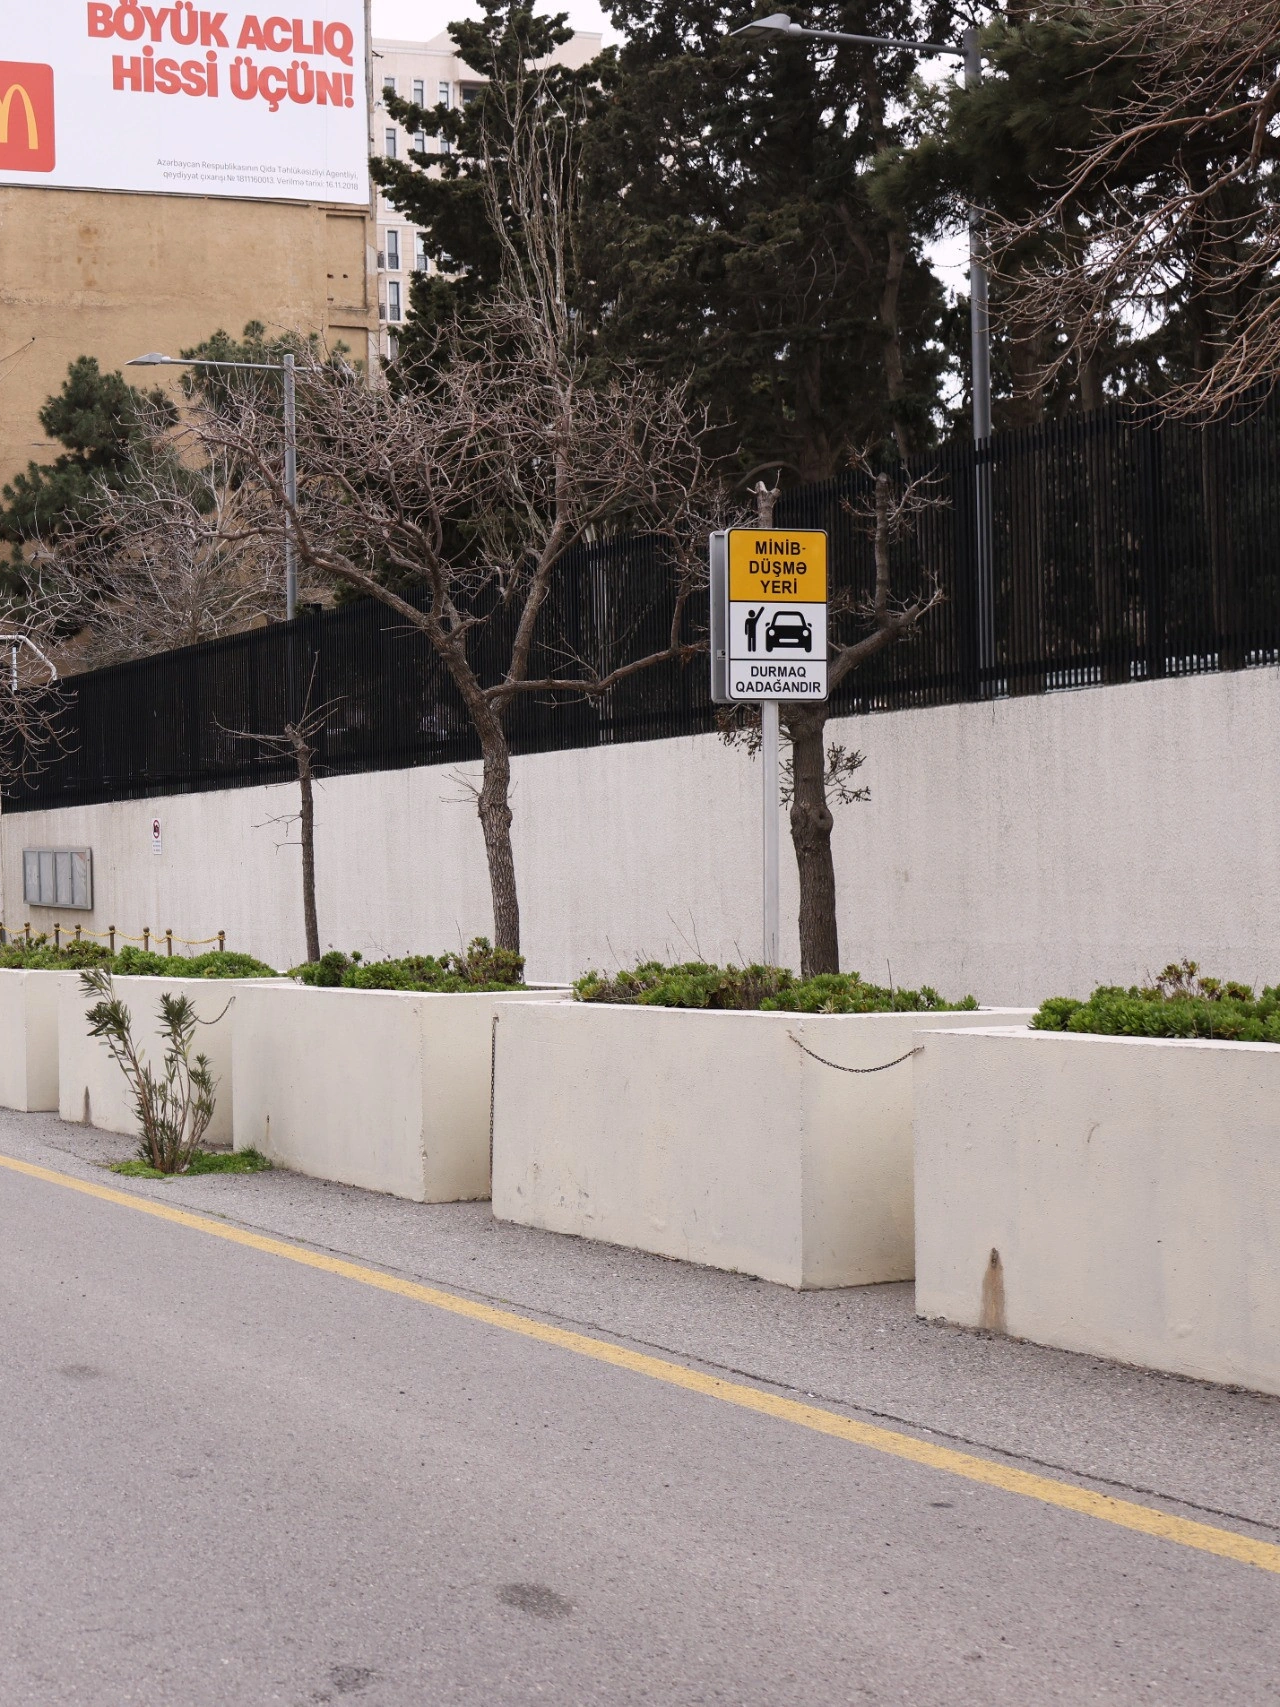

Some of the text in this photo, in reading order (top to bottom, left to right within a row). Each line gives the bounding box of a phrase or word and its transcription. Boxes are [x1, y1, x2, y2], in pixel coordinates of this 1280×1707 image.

[87, 0, 353, 66] BÖYÜK ACLIQ
[112, 45, 354, 112] HİSSİ ÜÇÜN!
[259, 164, 276, 173] Qida
[755, 539, 806, 556] MİNİB-
[749, 558, 807, 577] DÜŞMƏ
[760, 578, 797, 594] YERİ
[750, 666, 807, 678] DURMAQ
[735, 679, 821, 693] QADAĞANDIR
